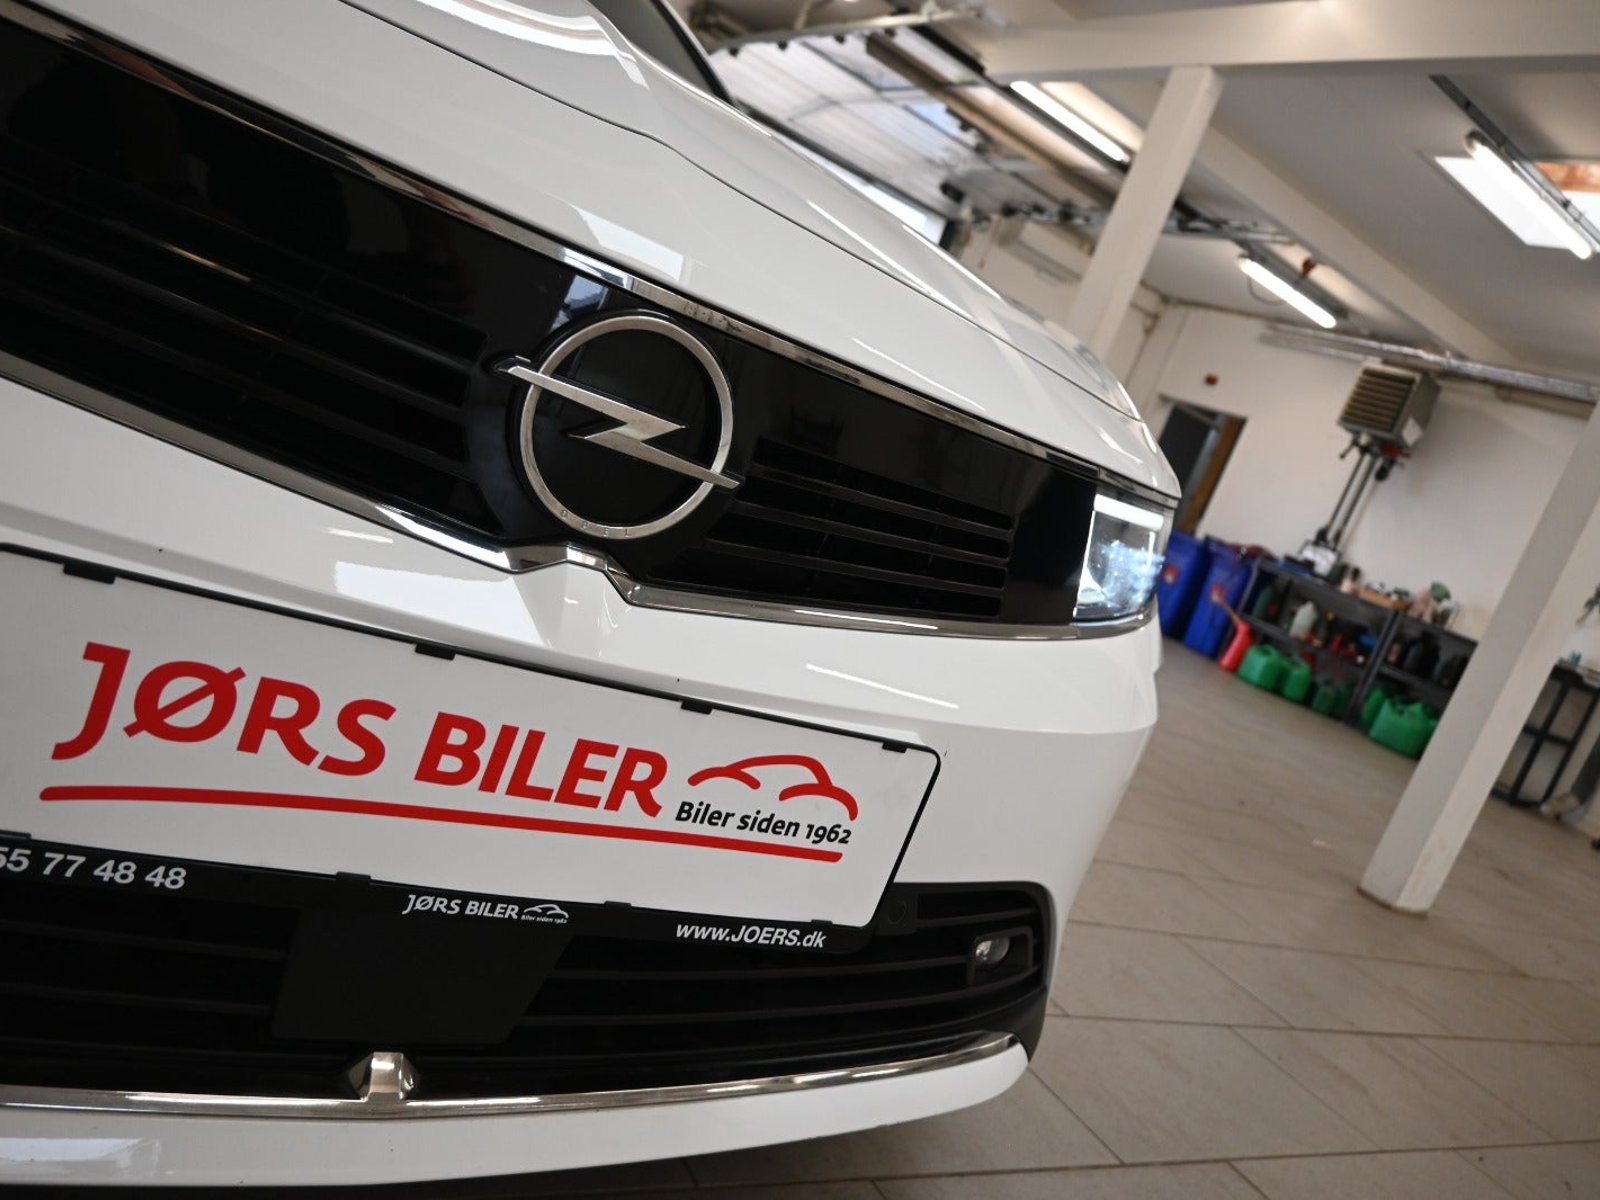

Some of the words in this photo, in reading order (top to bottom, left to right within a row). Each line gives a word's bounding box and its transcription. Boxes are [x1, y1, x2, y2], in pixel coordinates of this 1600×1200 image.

[561, 509, 632, 538] OPEL
[51, 641, 397, 776] JØRS
[413, 711, 668, 818] BILER
[675, 801, 735, 828] Biler
[736, 810, 801, 838] siden
[805, 823, 852, 845] 1962
[42, 852, 87, 878] 77
[93, 859, 137, 884] 48
[145, 865, 187, 889] 48
[401, 894, 462, 915] JØRS
[464, 900, 519, 920] BILER
[675, 923, 827, 948] www.JOERS.dk
